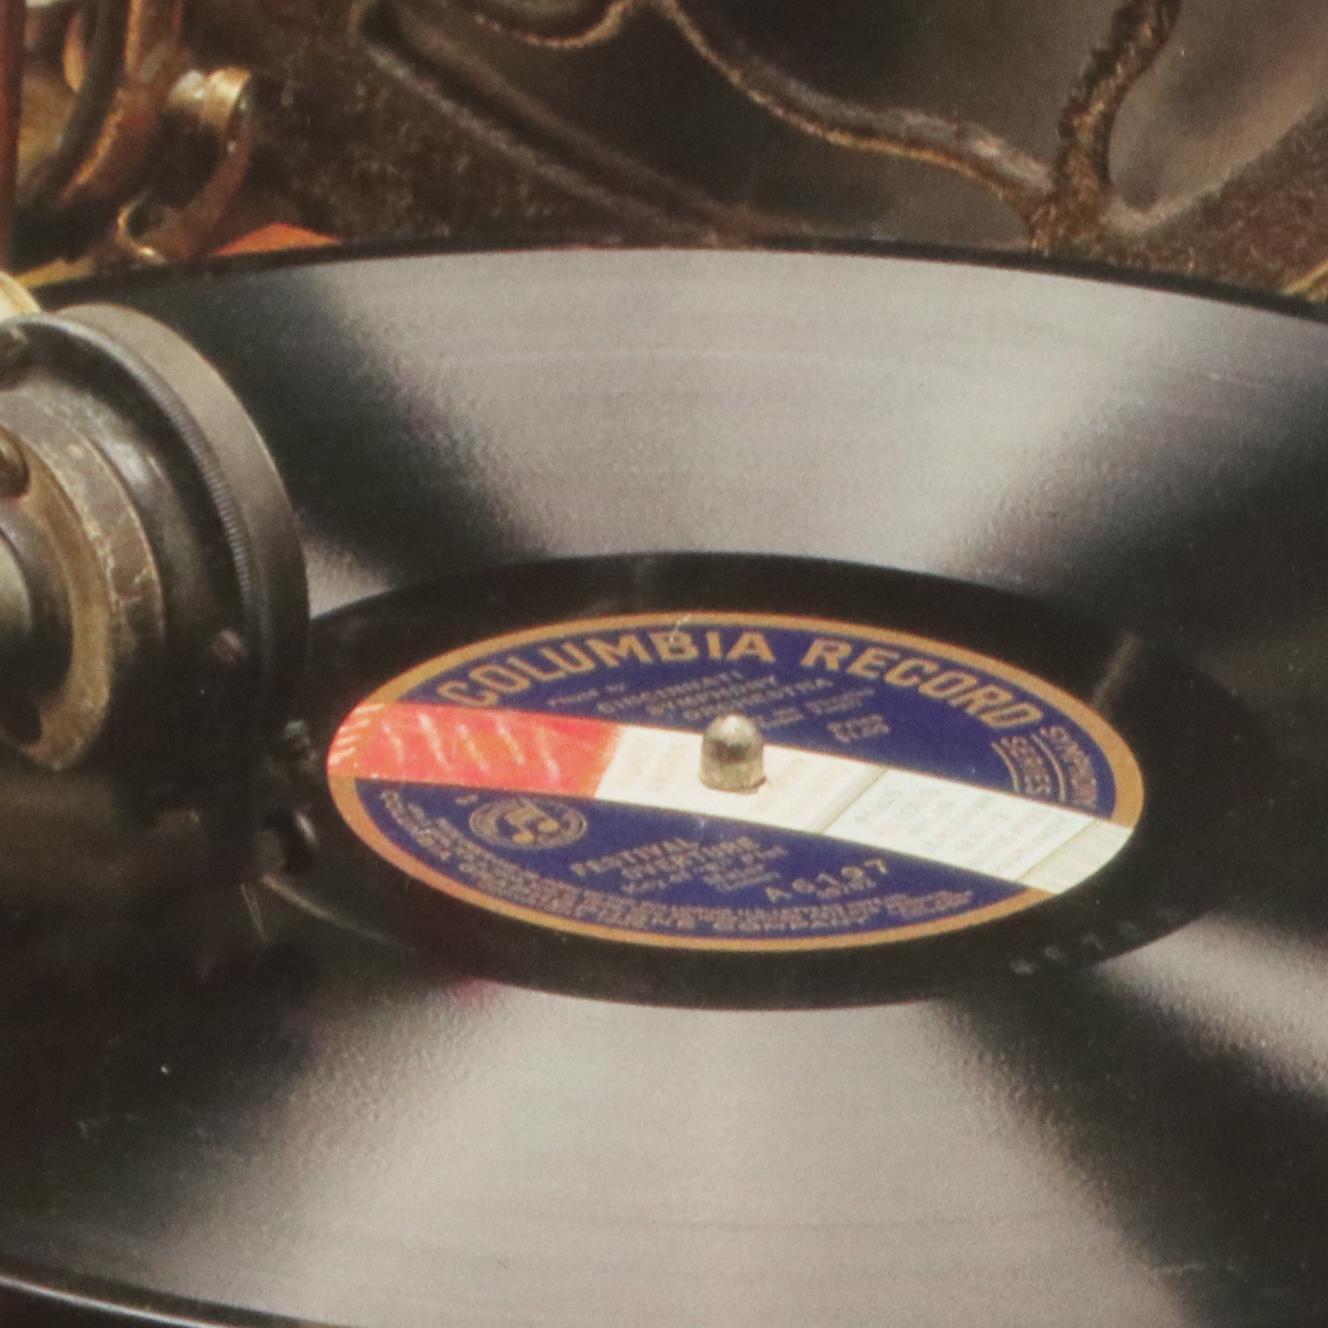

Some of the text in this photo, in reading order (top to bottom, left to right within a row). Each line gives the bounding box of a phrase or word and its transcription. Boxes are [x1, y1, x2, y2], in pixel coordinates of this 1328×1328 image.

[436, 630, 776, 707] COLUMBIA
[800, 637, 1044, 729] RECORD
[1001, 735, 1051, 796] SERIES
